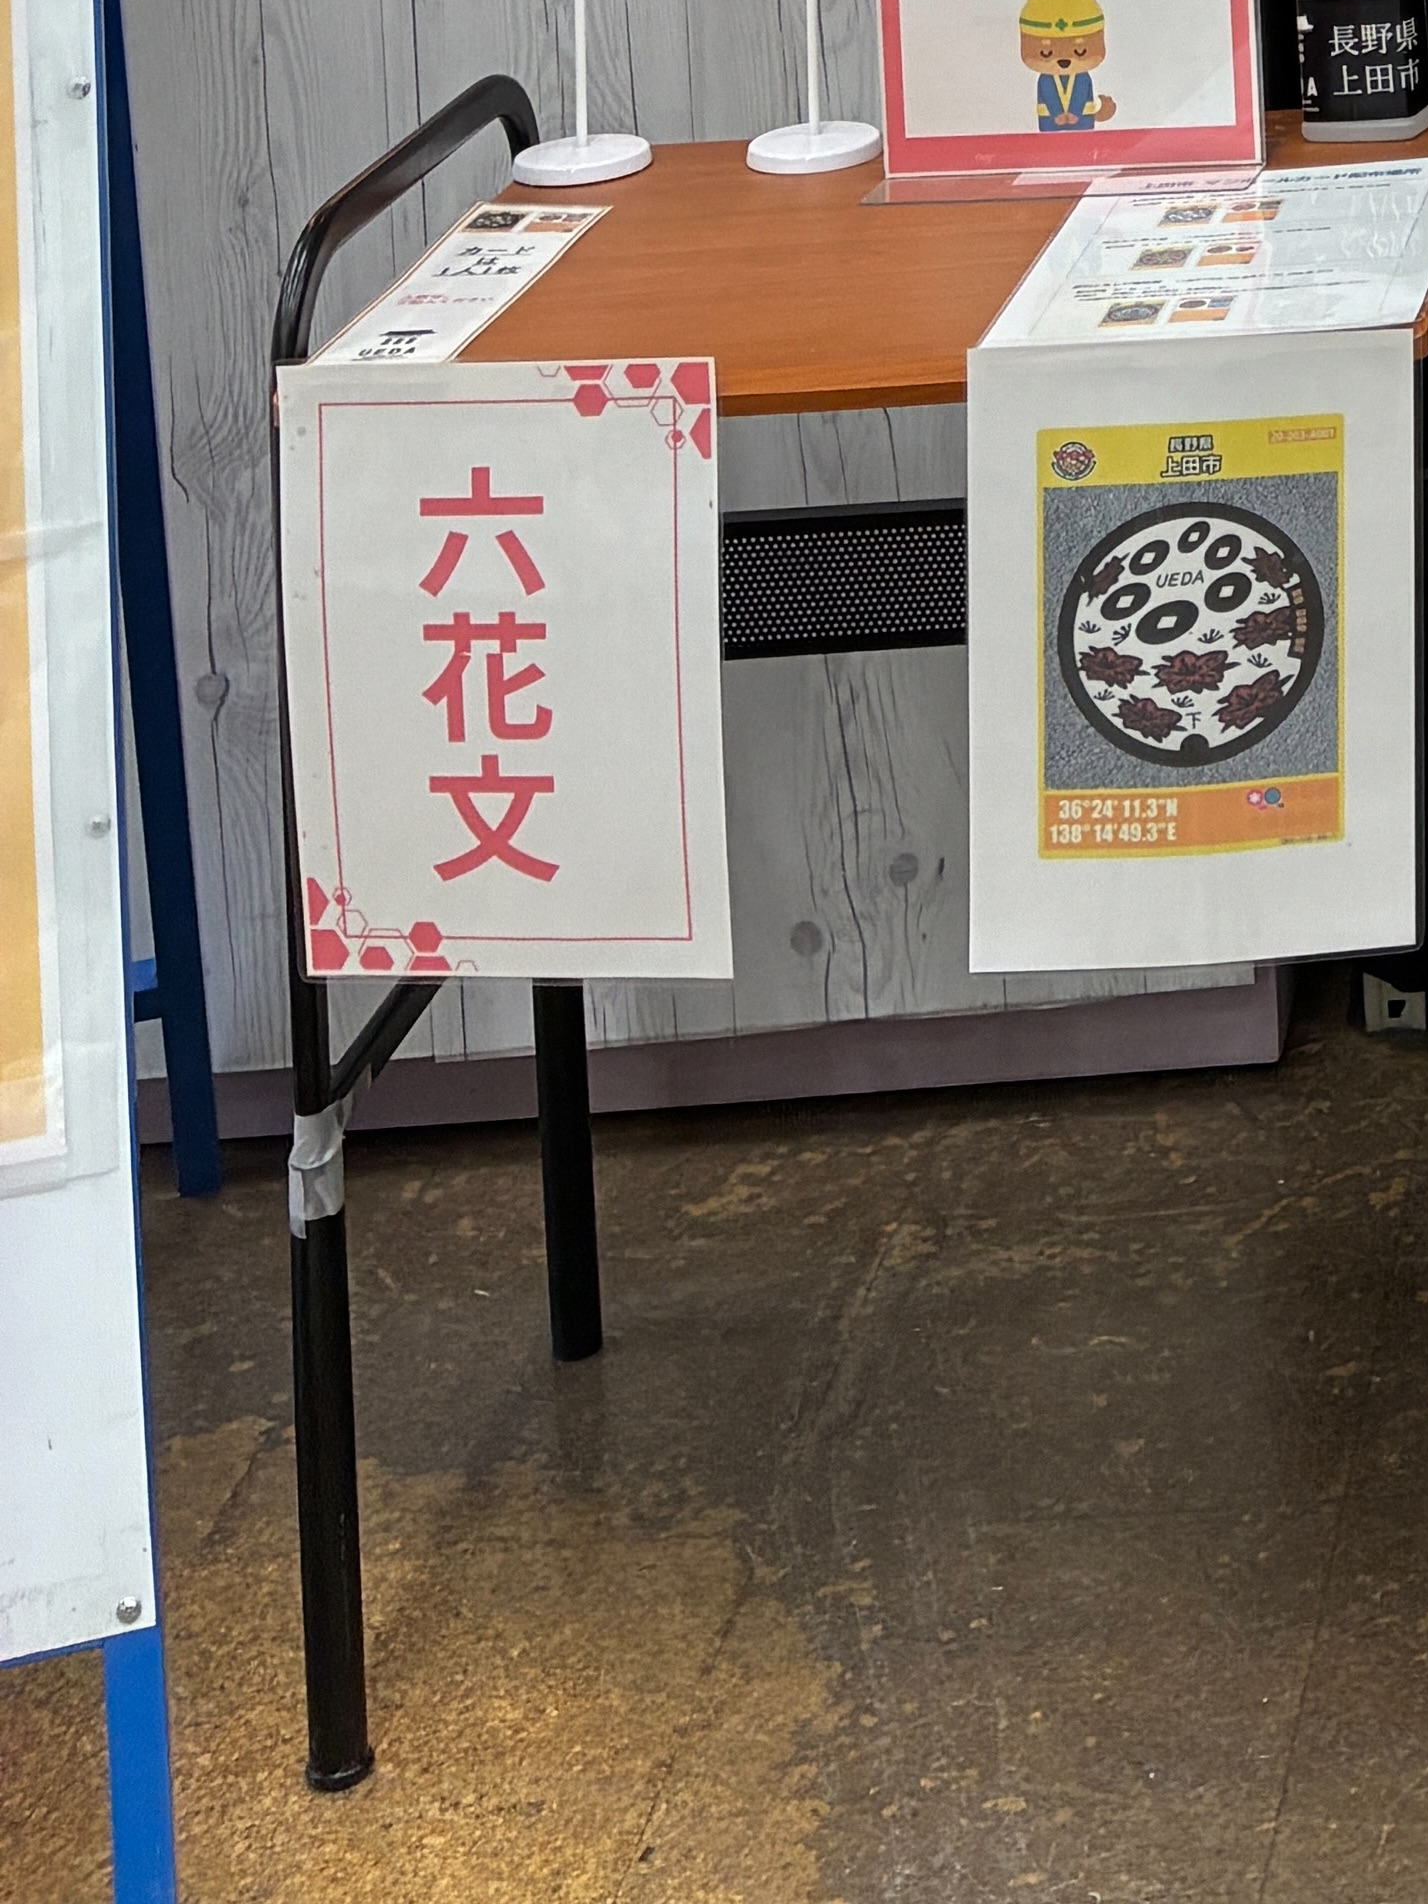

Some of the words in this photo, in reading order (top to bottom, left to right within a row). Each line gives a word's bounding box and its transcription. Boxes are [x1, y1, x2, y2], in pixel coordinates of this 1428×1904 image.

[1328, 16, 1418, 57] 長野県
[1332, 58, 1420, 97] 上田市
[1160, 454, 1222, 478] 上田市
[1155, 568, 1205, 589] UEDA
[418, 464, 561, 884] 六花文
